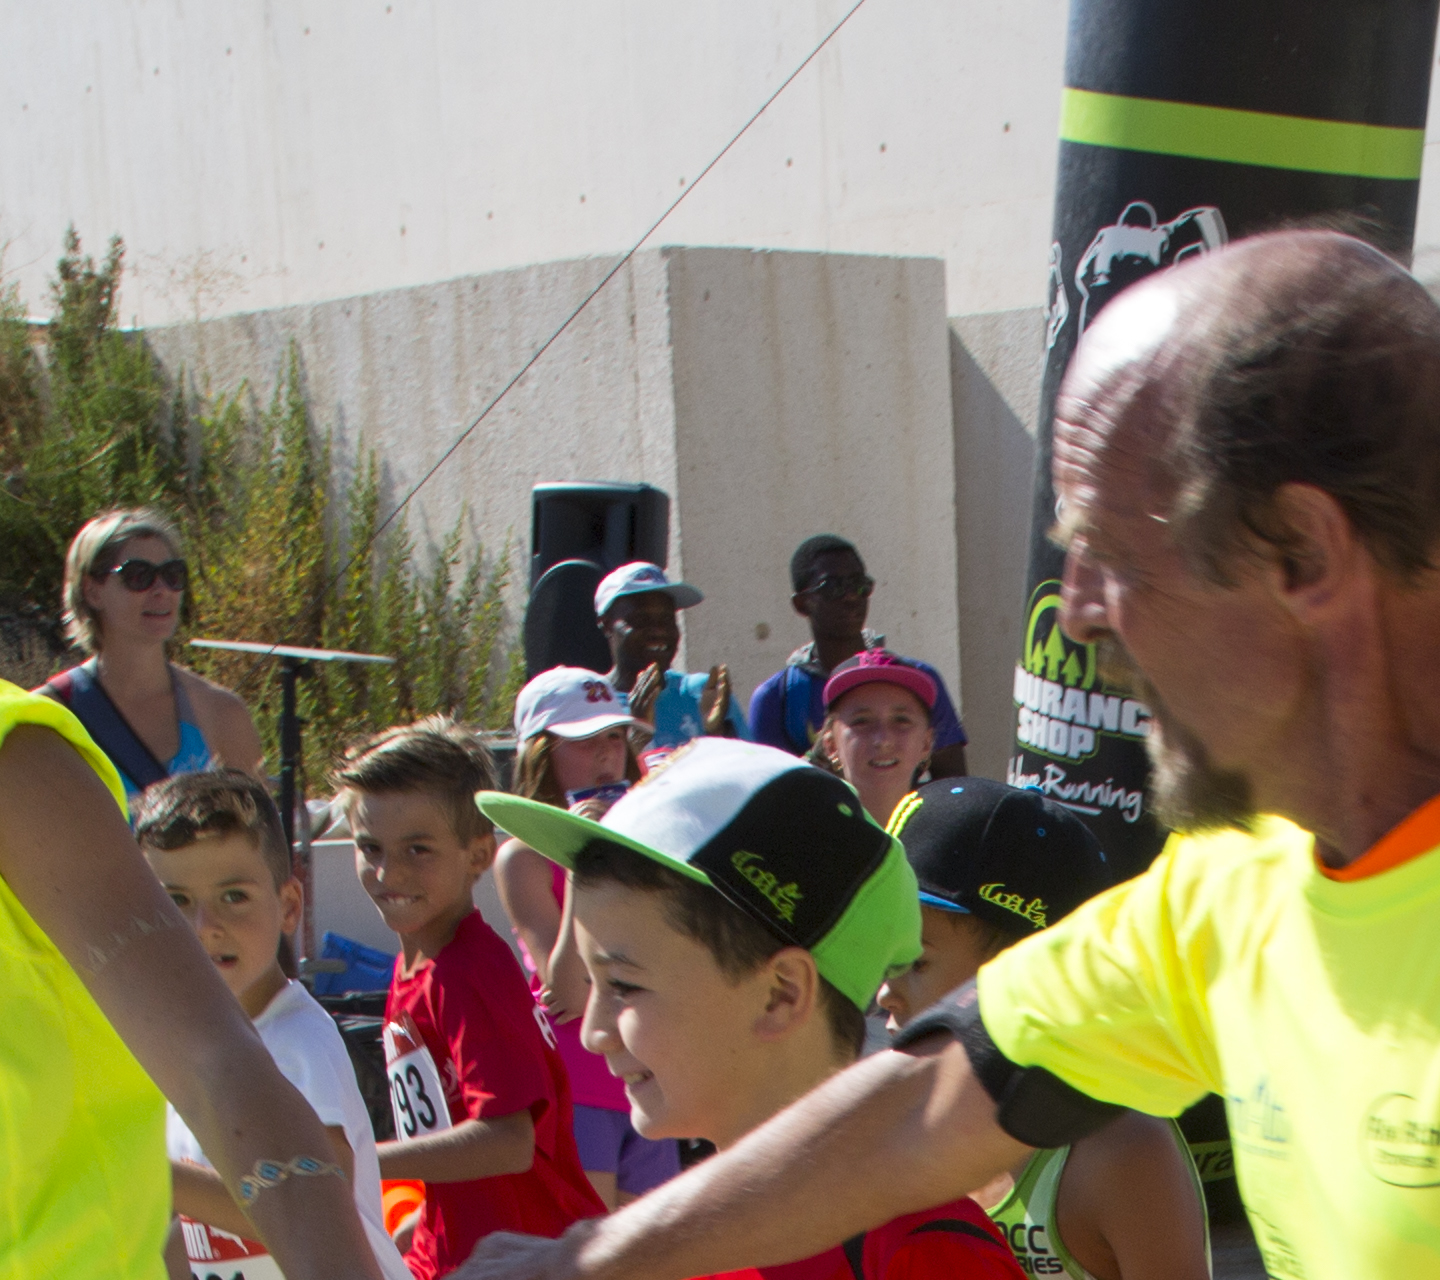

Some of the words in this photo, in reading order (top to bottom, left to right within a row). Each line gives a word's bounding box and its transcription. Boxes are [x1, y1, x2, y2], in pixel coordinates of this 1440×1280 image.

[1017, 706, 1096, 759] SHOP
[1043, 763, 1142, 823] Running
[389, 1063, 438, 1138] 93
[181, 1220, 214, 1260] MA
[1020, 1256, 1063, 1275] RIES
